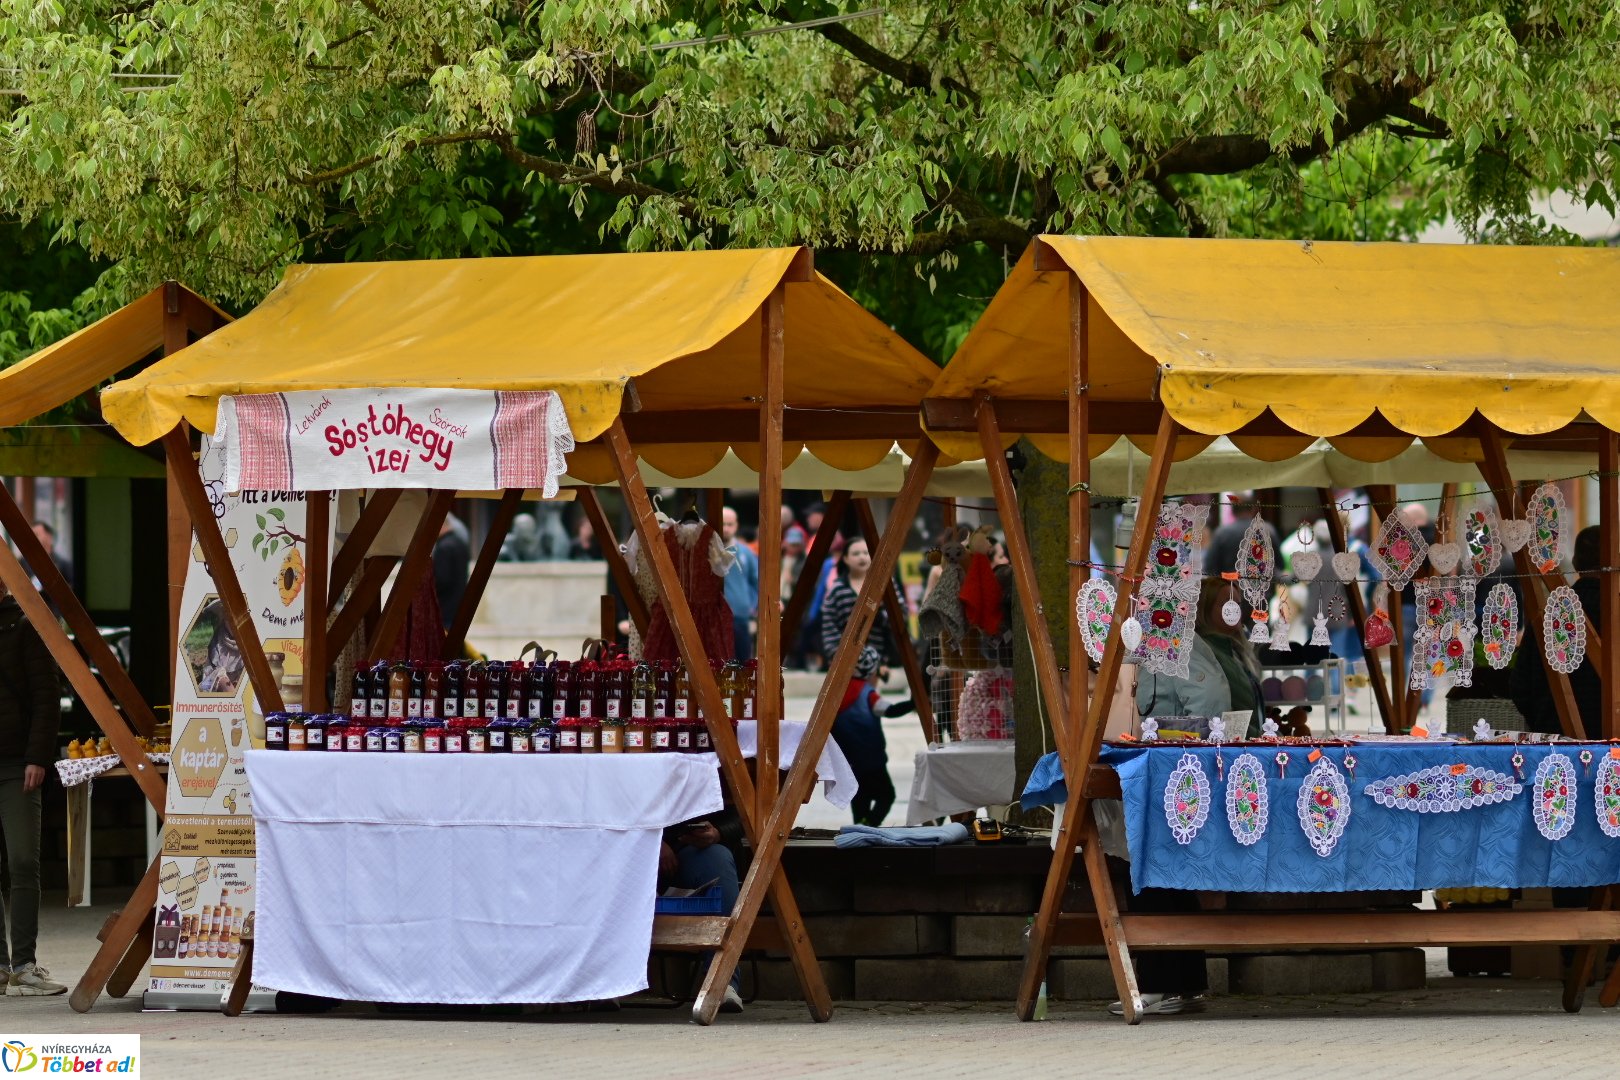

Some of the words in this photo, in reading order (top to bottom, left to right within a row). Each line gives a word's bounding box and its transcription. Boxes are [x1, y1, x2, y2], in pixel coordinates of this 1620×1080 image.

[295, 396, 332, 435] Lekvárok
[324, 403, 454, 471] Sóstóhegy
[363, 446, 411, 474] izei
[262, 608, 287, 627] Deme
[290, 609, 304, 625] mé
[176, 701, 243, 713] Immunerősítés
[199, 726, 208, 743] a
[180, 747, 225, 774] kaptár
[181, 776, 216, 791] erejével
